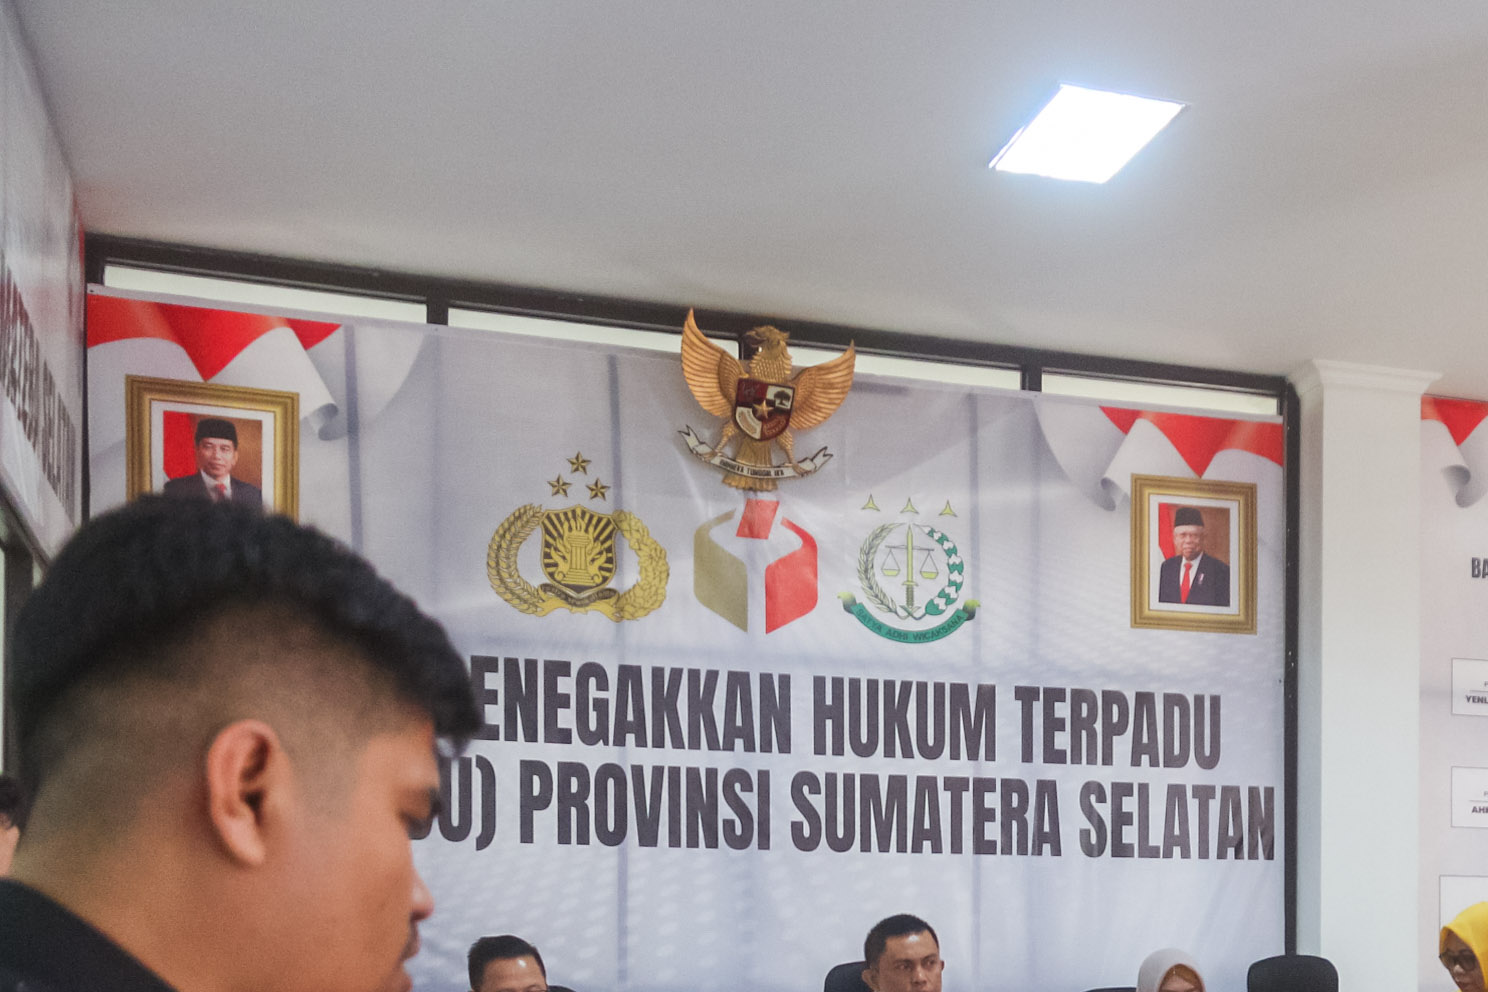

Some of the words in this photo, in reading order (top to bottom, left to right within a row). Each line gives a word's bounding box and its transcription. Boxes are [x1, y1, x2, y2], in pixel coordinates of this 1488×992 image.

[856, 608, 883, 633] SATYA
[885, 629, 908, 641] ADHI
[913, 615, 963, 641] WICAKSANA
[470, 655, 791, 755] ENEGAKKAN
[813, 675, 996, 762] HUKUM
[1014, 685, 1221, 770] TERPADU
[519, 759, 770, 851] PROVINSI
[790, 770, 1062, 857] SUMATERA
[1079, 780, 1275, 861] SELATAN
